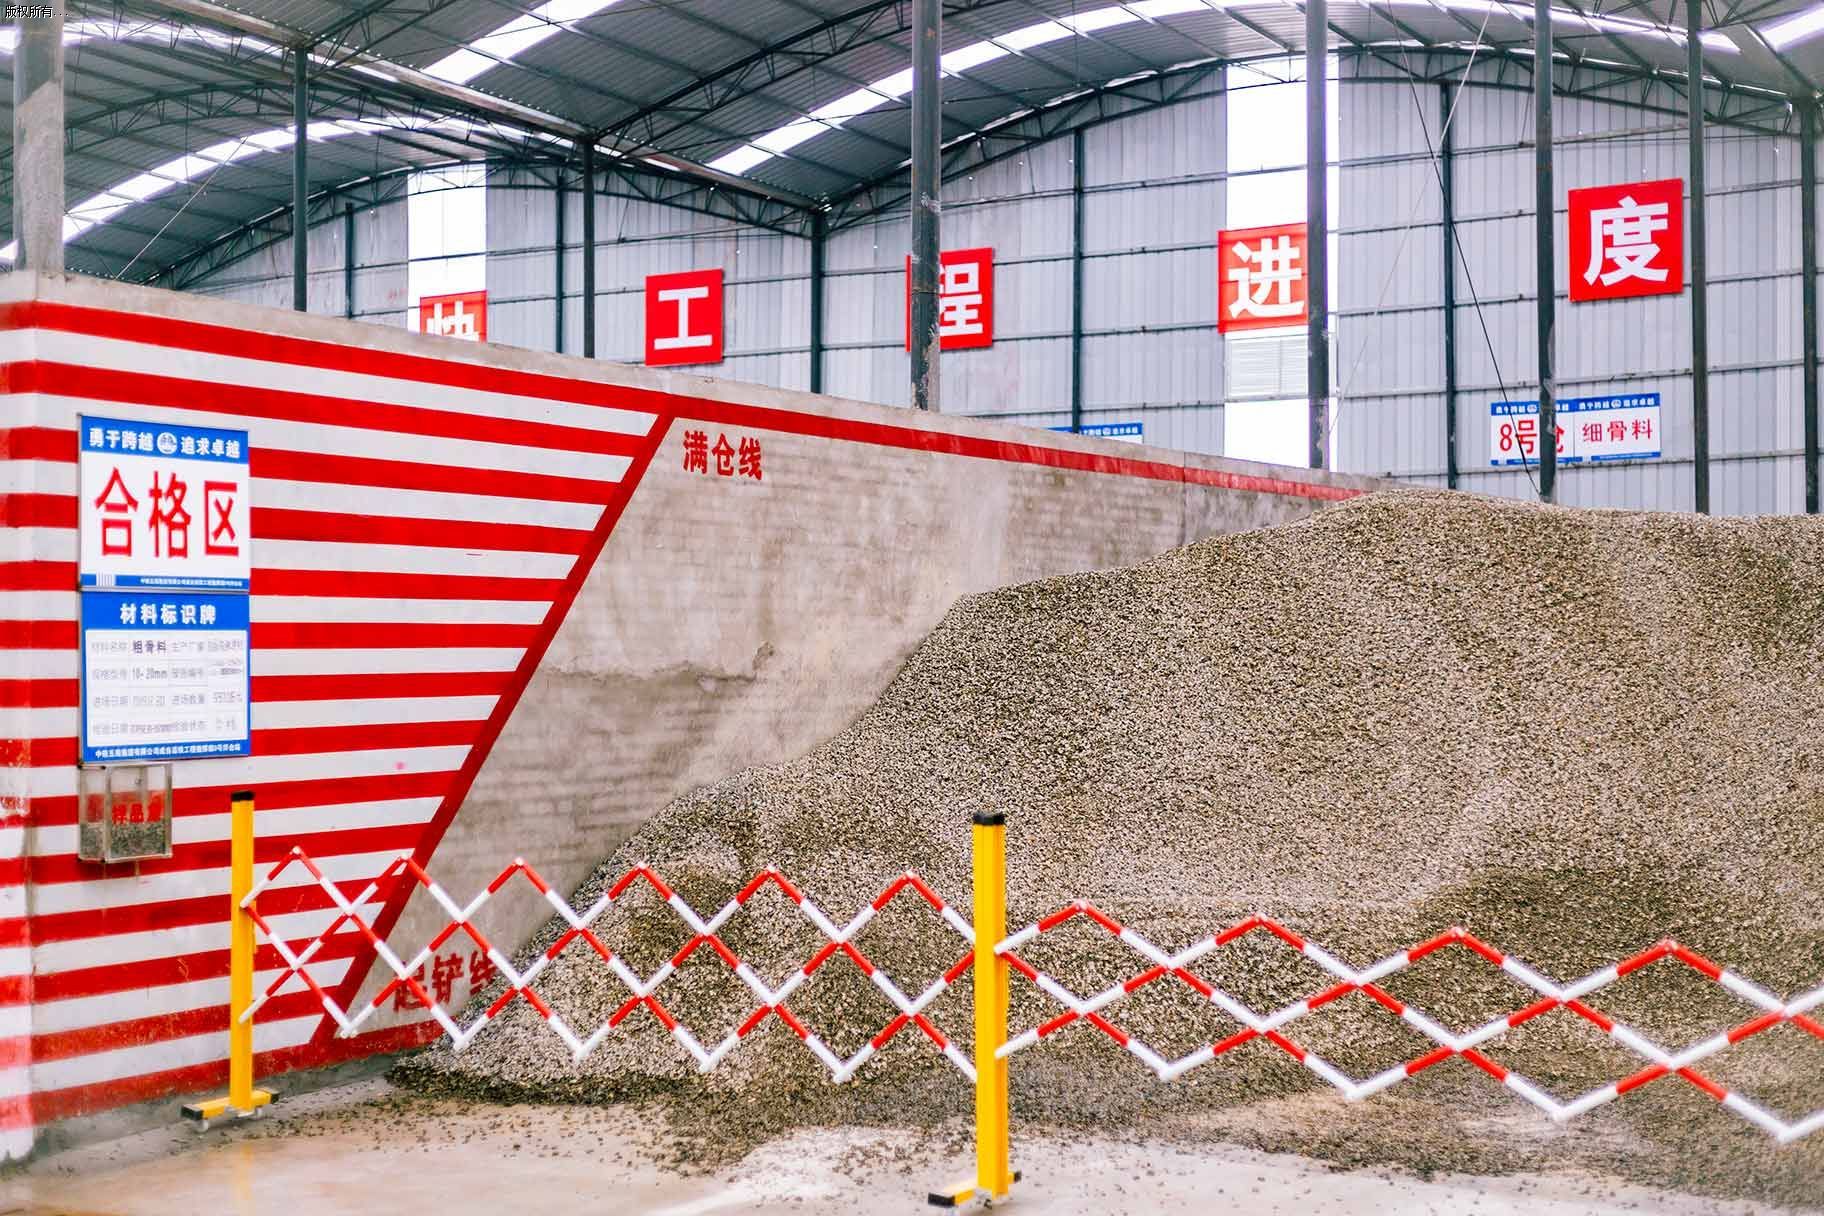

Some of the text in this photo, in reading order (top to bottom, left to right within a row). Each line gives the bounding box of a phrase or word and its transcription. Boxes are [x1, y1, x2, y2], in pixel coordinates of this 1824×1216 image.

[653, 286, 713, 350] 工
[1228, 235, 1305, 319] 进
[1583, 195, 1669, 287] 度
[89, 427, 240, 459] 勇于跨越 追求卓越
[1582, 418, 1653, 442] 细骨料
[683, 430, 763, 481] 满仓线
[95, 467, 240, 559] 合格区
[119, 602, 216, 625] 材料标识牌
